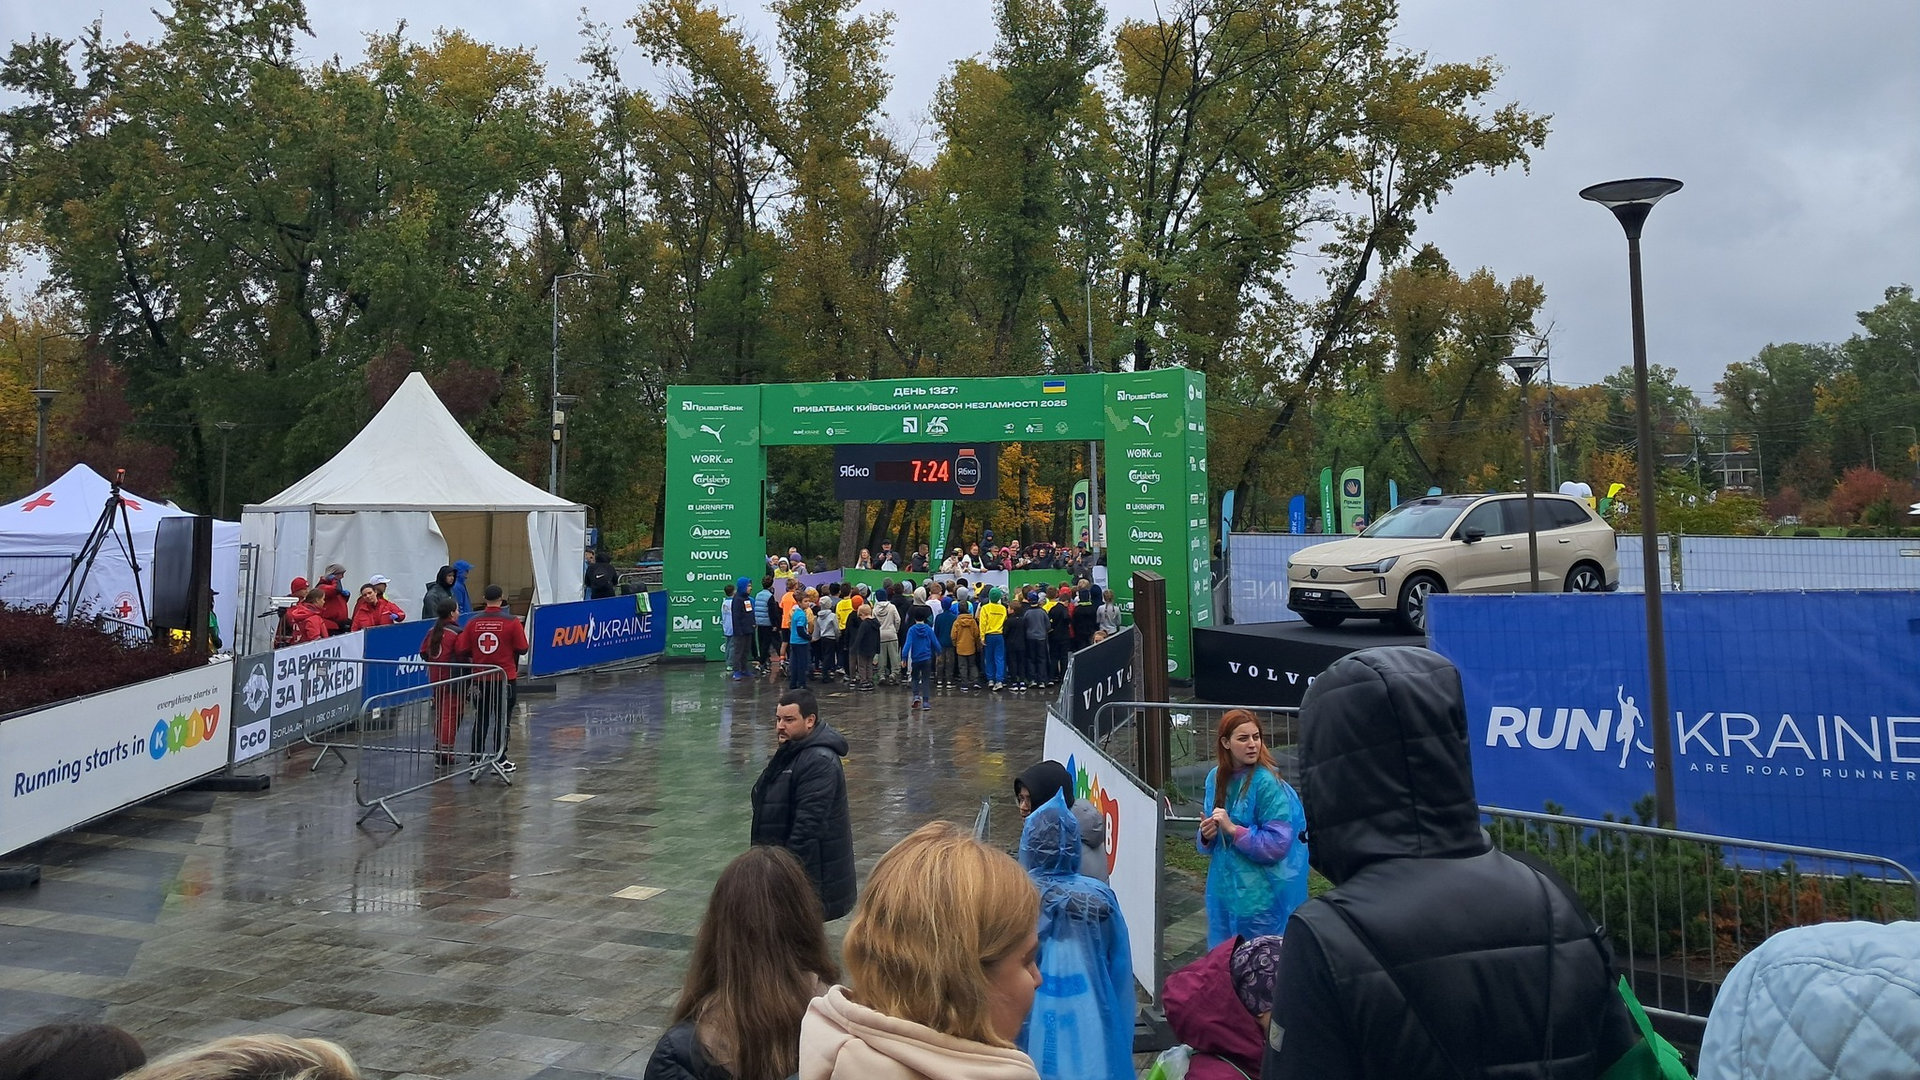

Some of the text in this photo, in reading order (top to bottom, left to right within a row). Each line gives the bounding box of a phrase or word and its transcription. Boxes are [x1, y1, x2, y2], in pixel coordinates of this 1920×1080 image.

[893, 386, 959, 397] ДЕНЬ 1327:
[793, 400, 1068, 413] ПРИВАТБАНК КИЇВСЬКИЙ МАРАФОН НЕЗЛАМНОСТІ 2025
[839, 466, 870, 478] Ябко
[911, 460, 949, 482] 7:24
[957, 467, 977, 476] Ябко
[1128, 469, 1160, 485] Carlsberg
[692, 473, 731, 487] Carlsberg
[690, 551, 729, 560] NOVUS
[1130, 555, 1163, 566] NOVUS
[552, 623, 589, 648] RUN
[592, 614, 653, 641] UKRAINE
[156, 684, 219, 711] everything starts in
[275, 684, 296, 709] ЗА
[155, 716, 214, 749] KYIV
[1485, 706, 1613, 752] RUN
[14, 735, 145, 797] Running starts in
[1690, 763, 1729, 774] ARE
[1746, 765, 1805, 777] ROAD
